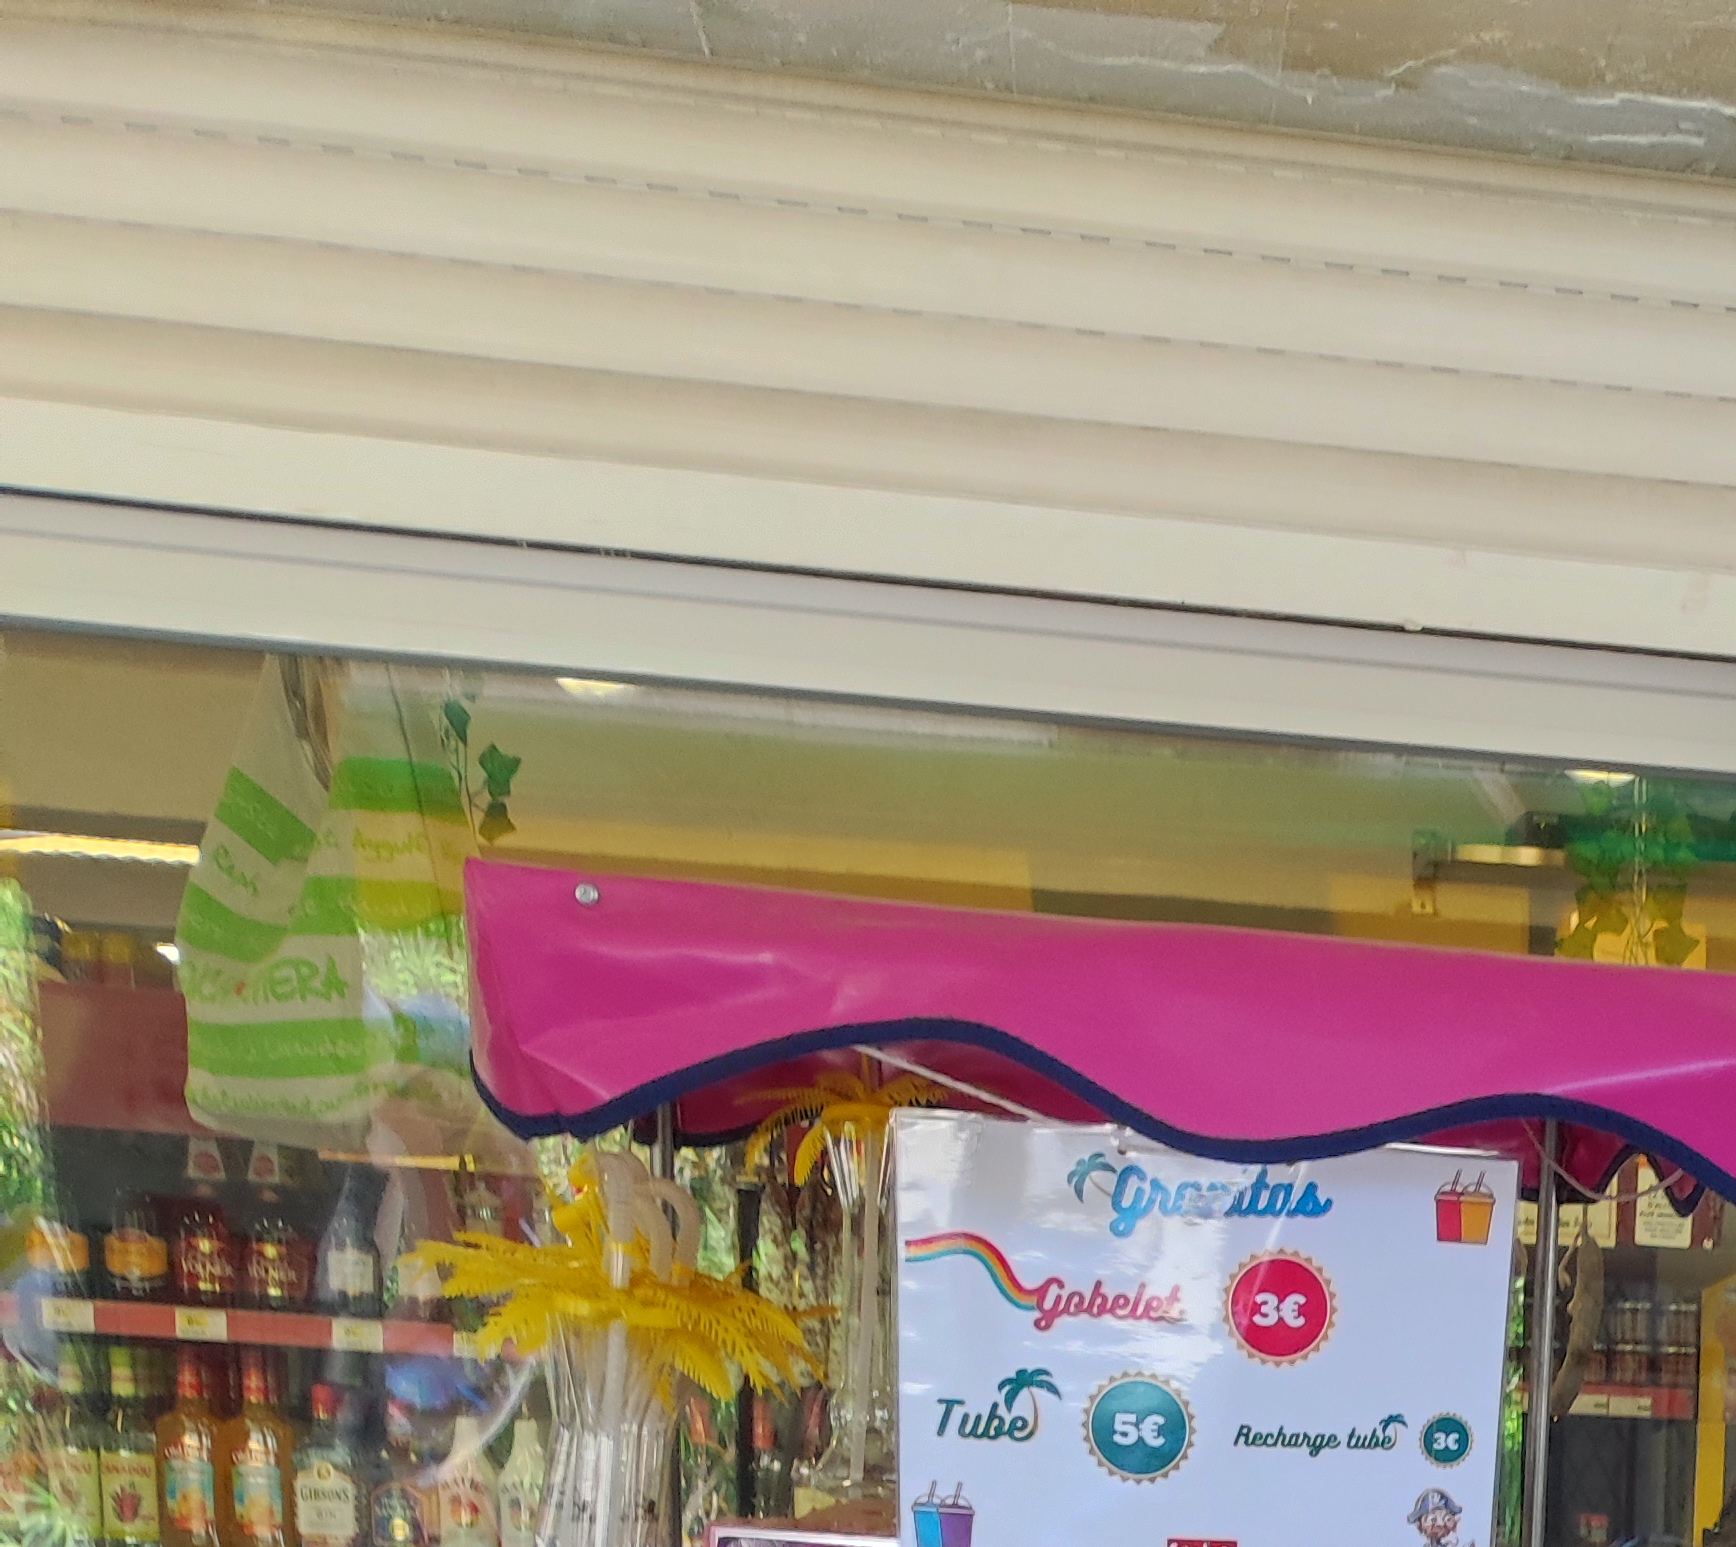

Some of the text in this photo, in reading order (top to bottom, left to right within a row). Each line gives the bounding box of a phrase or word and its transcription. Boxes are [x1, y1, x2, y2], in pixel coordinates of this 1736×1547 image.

[1033, 1276, 1307, 1331] Gobelet 3€
[936, 1398, 1167, 1448] Tube 5€
[1233, 1424, 1342, 1458] Recharge
[1346, 1426, 1395, 1451] tube
